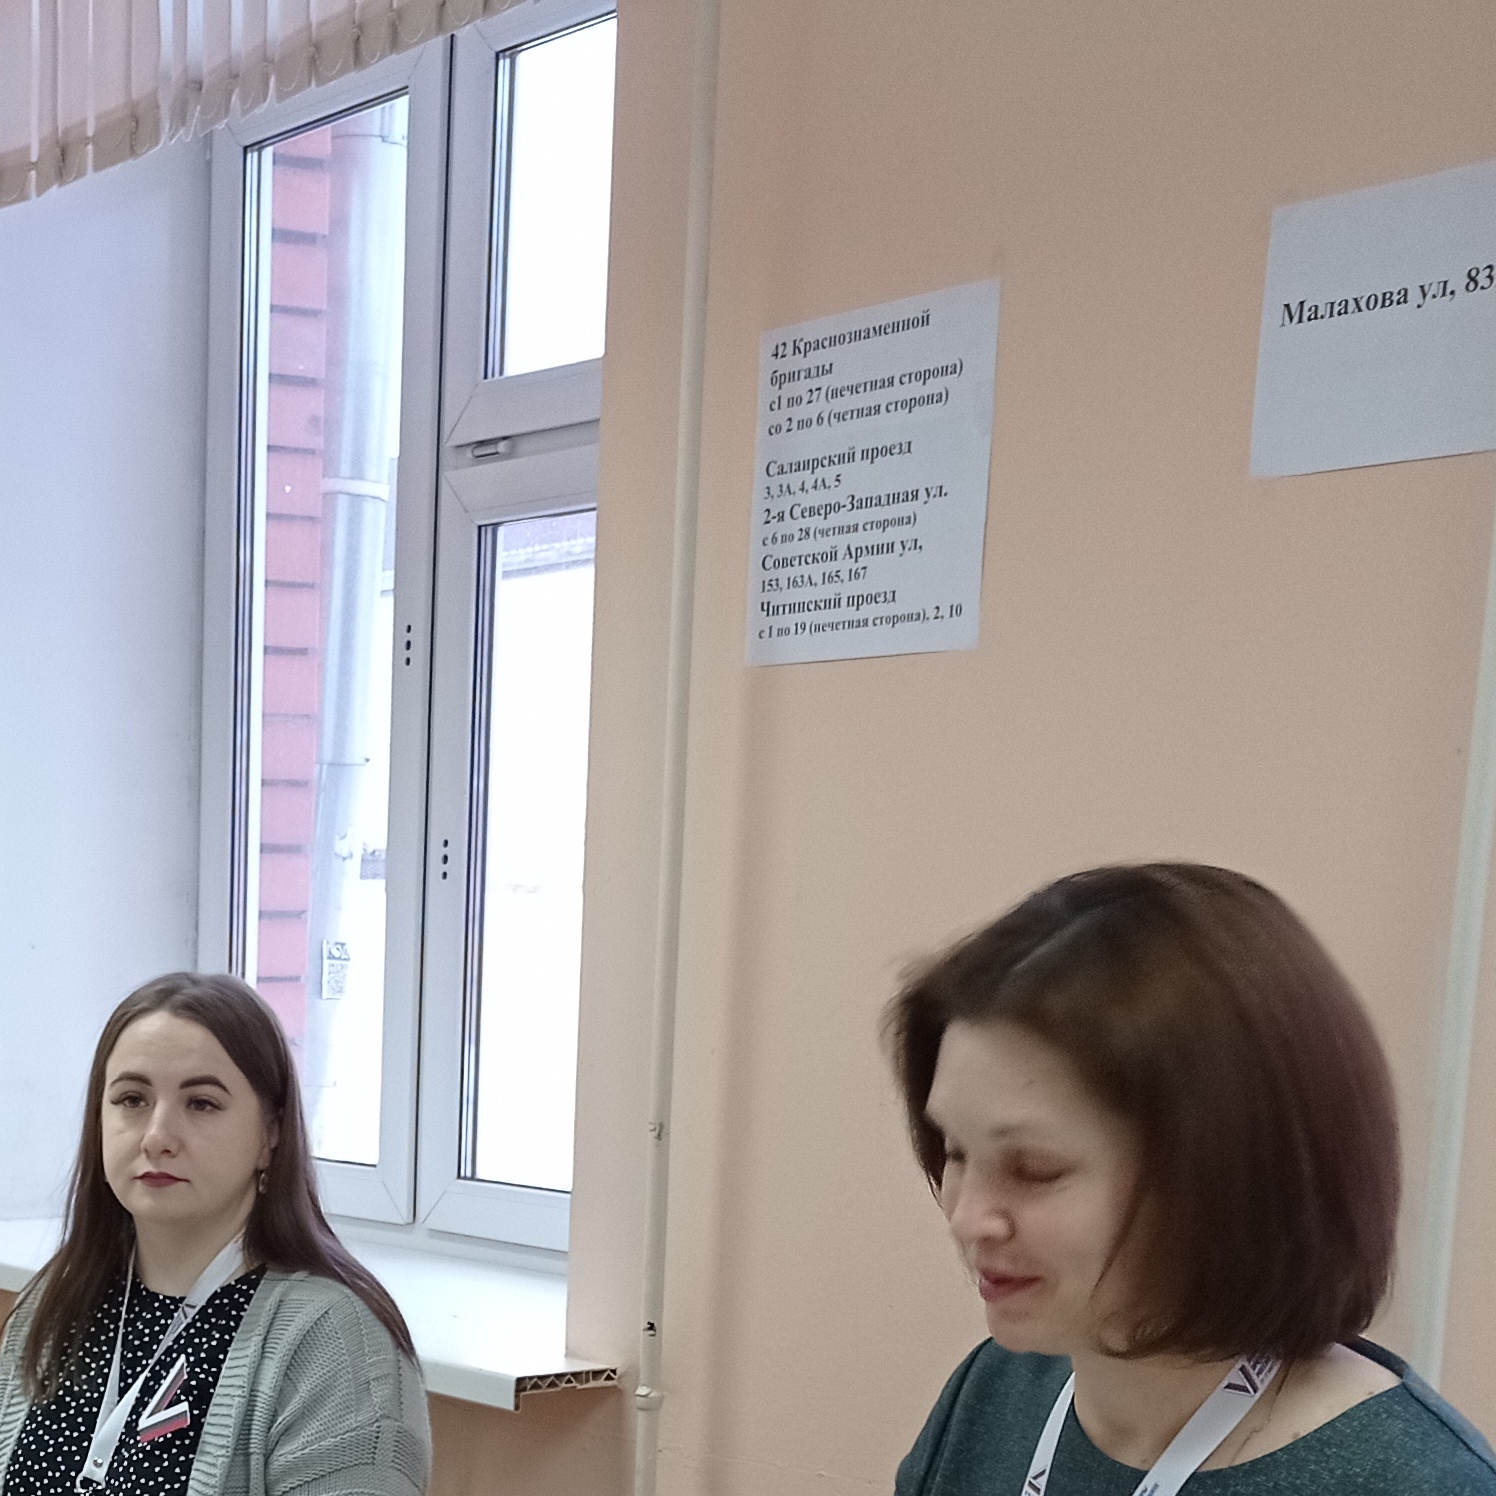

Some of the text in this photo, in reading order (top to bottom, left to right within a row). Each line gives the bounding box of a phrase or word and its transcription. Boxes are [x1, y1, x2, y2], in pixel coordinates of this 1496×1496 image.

[1279, 264, 1494, 327] Малахова ул, 83
[770, 308, 931, 361] 42 Краснознаменной
[770, 362, 834, 391] бригады
[786, 394, 803, 409] по
[805, 386, 823, 406] 27
[824, 375, 895, 404] (нечетная
[898, 357, 964, 387] сторона)
[767, 386, 950, 437] со 2 по 6 (четная сторона)
[765, 440, 913, 478] Салаирский проезд
[833, 473, 842, 489] 5
[762, 484, 949, 526] 2-я Северо-Западная ул.
[770, 531, 778, 546] 6
[780, 532, 795, 545] по
[797, 526, 812, 542] 28
[813, 522, 860, 542] (четная
[861, 511, 917, 534] сторона)
[761, 544, 839, 572] Советской
[841, 540, 896, 564] Армии
[847, 565, 868, 583] 167
[760, 589, 897, 618] Читинский проезд
[776, 626, 791, 638] по
[793, 621, 807, 636] 19
[808, 617, 870, 636] (нечетная
[948, 602, 963, 619] 10
